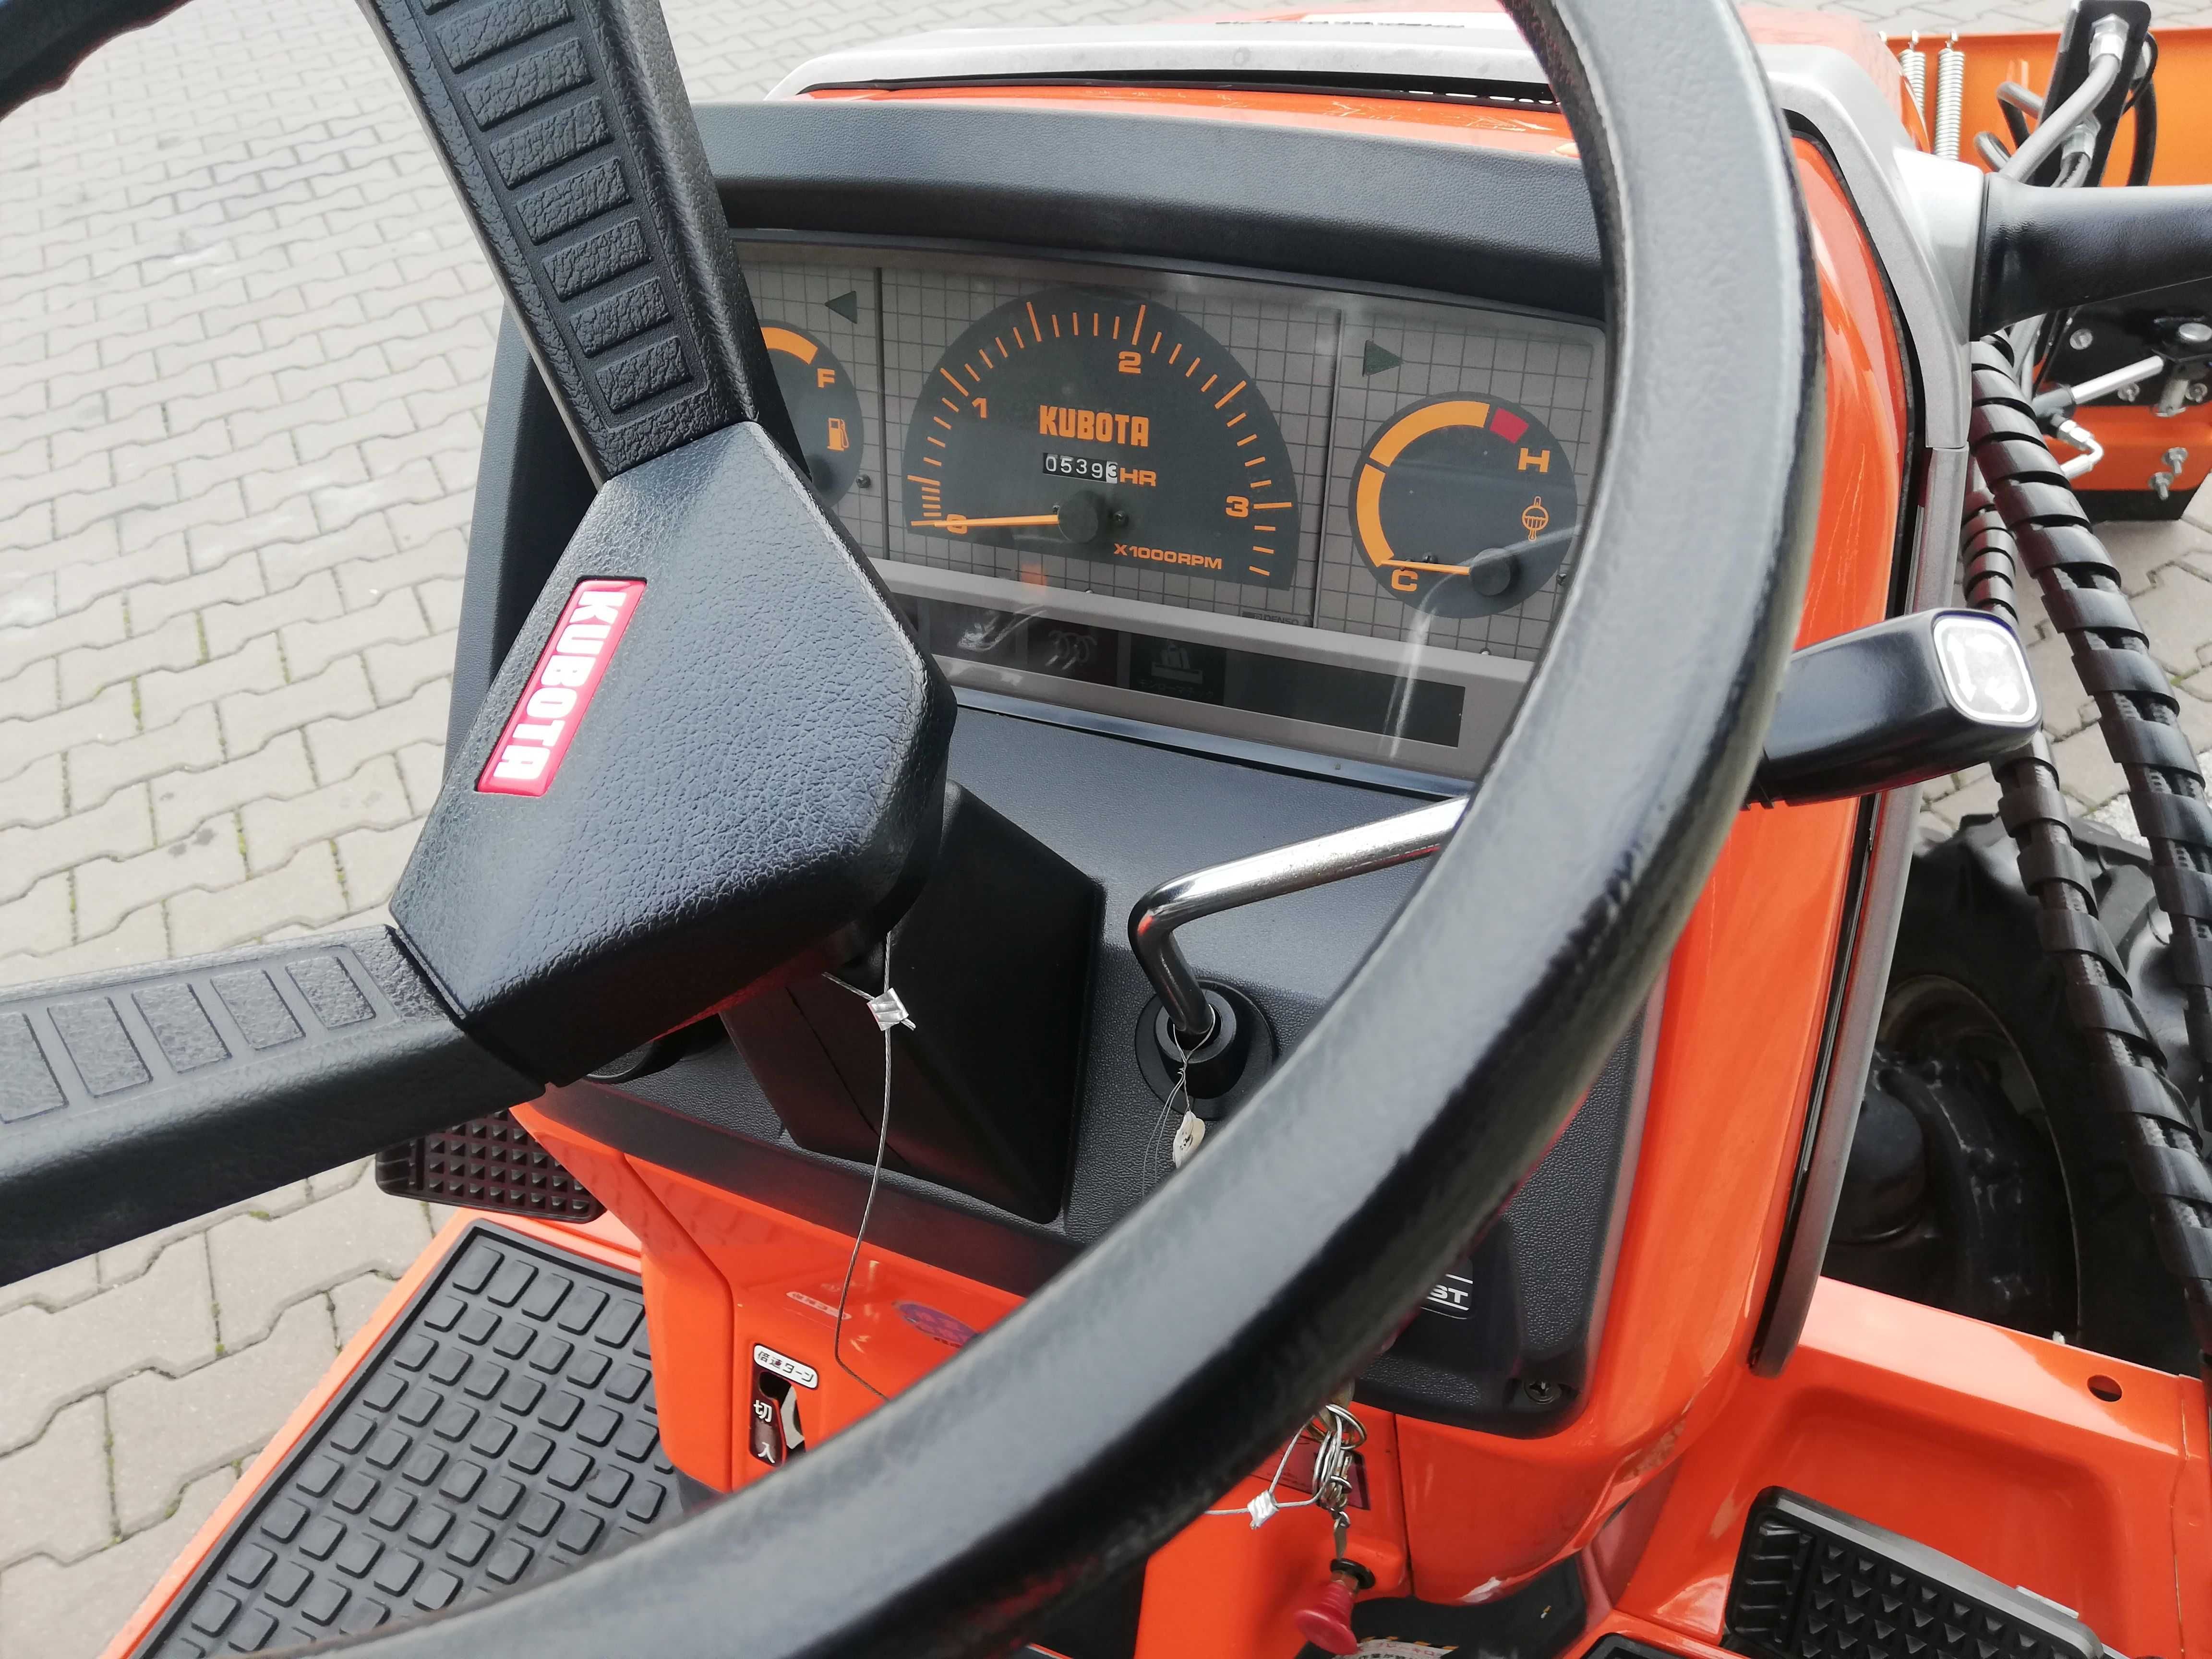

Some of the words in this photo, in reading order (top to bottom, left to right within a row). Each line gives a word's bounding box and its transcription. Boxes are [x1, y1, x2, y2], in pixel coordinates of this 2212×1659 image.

[1118, 351, 1141, 374] 2
[817, 368, 835, 387] F
[972, 397, 987, 419] 1
[1039, 405, 1149, 447] KUBOTA
[1517, 448, 1550, 472] H
[1119, 468, 1156, 487] HR
[1226, 495, 1249, 517] 3
[1391, 569, 1418, 592] C
[1264, 614, 1299, 625] DENSO
[493, 591, 627, 780] KUBOTA
[758, 1351, 814, 1382] 倍速ターン
[753, 1400, 772, 1422] 切
[757, 1442, 775, 1463] 入
